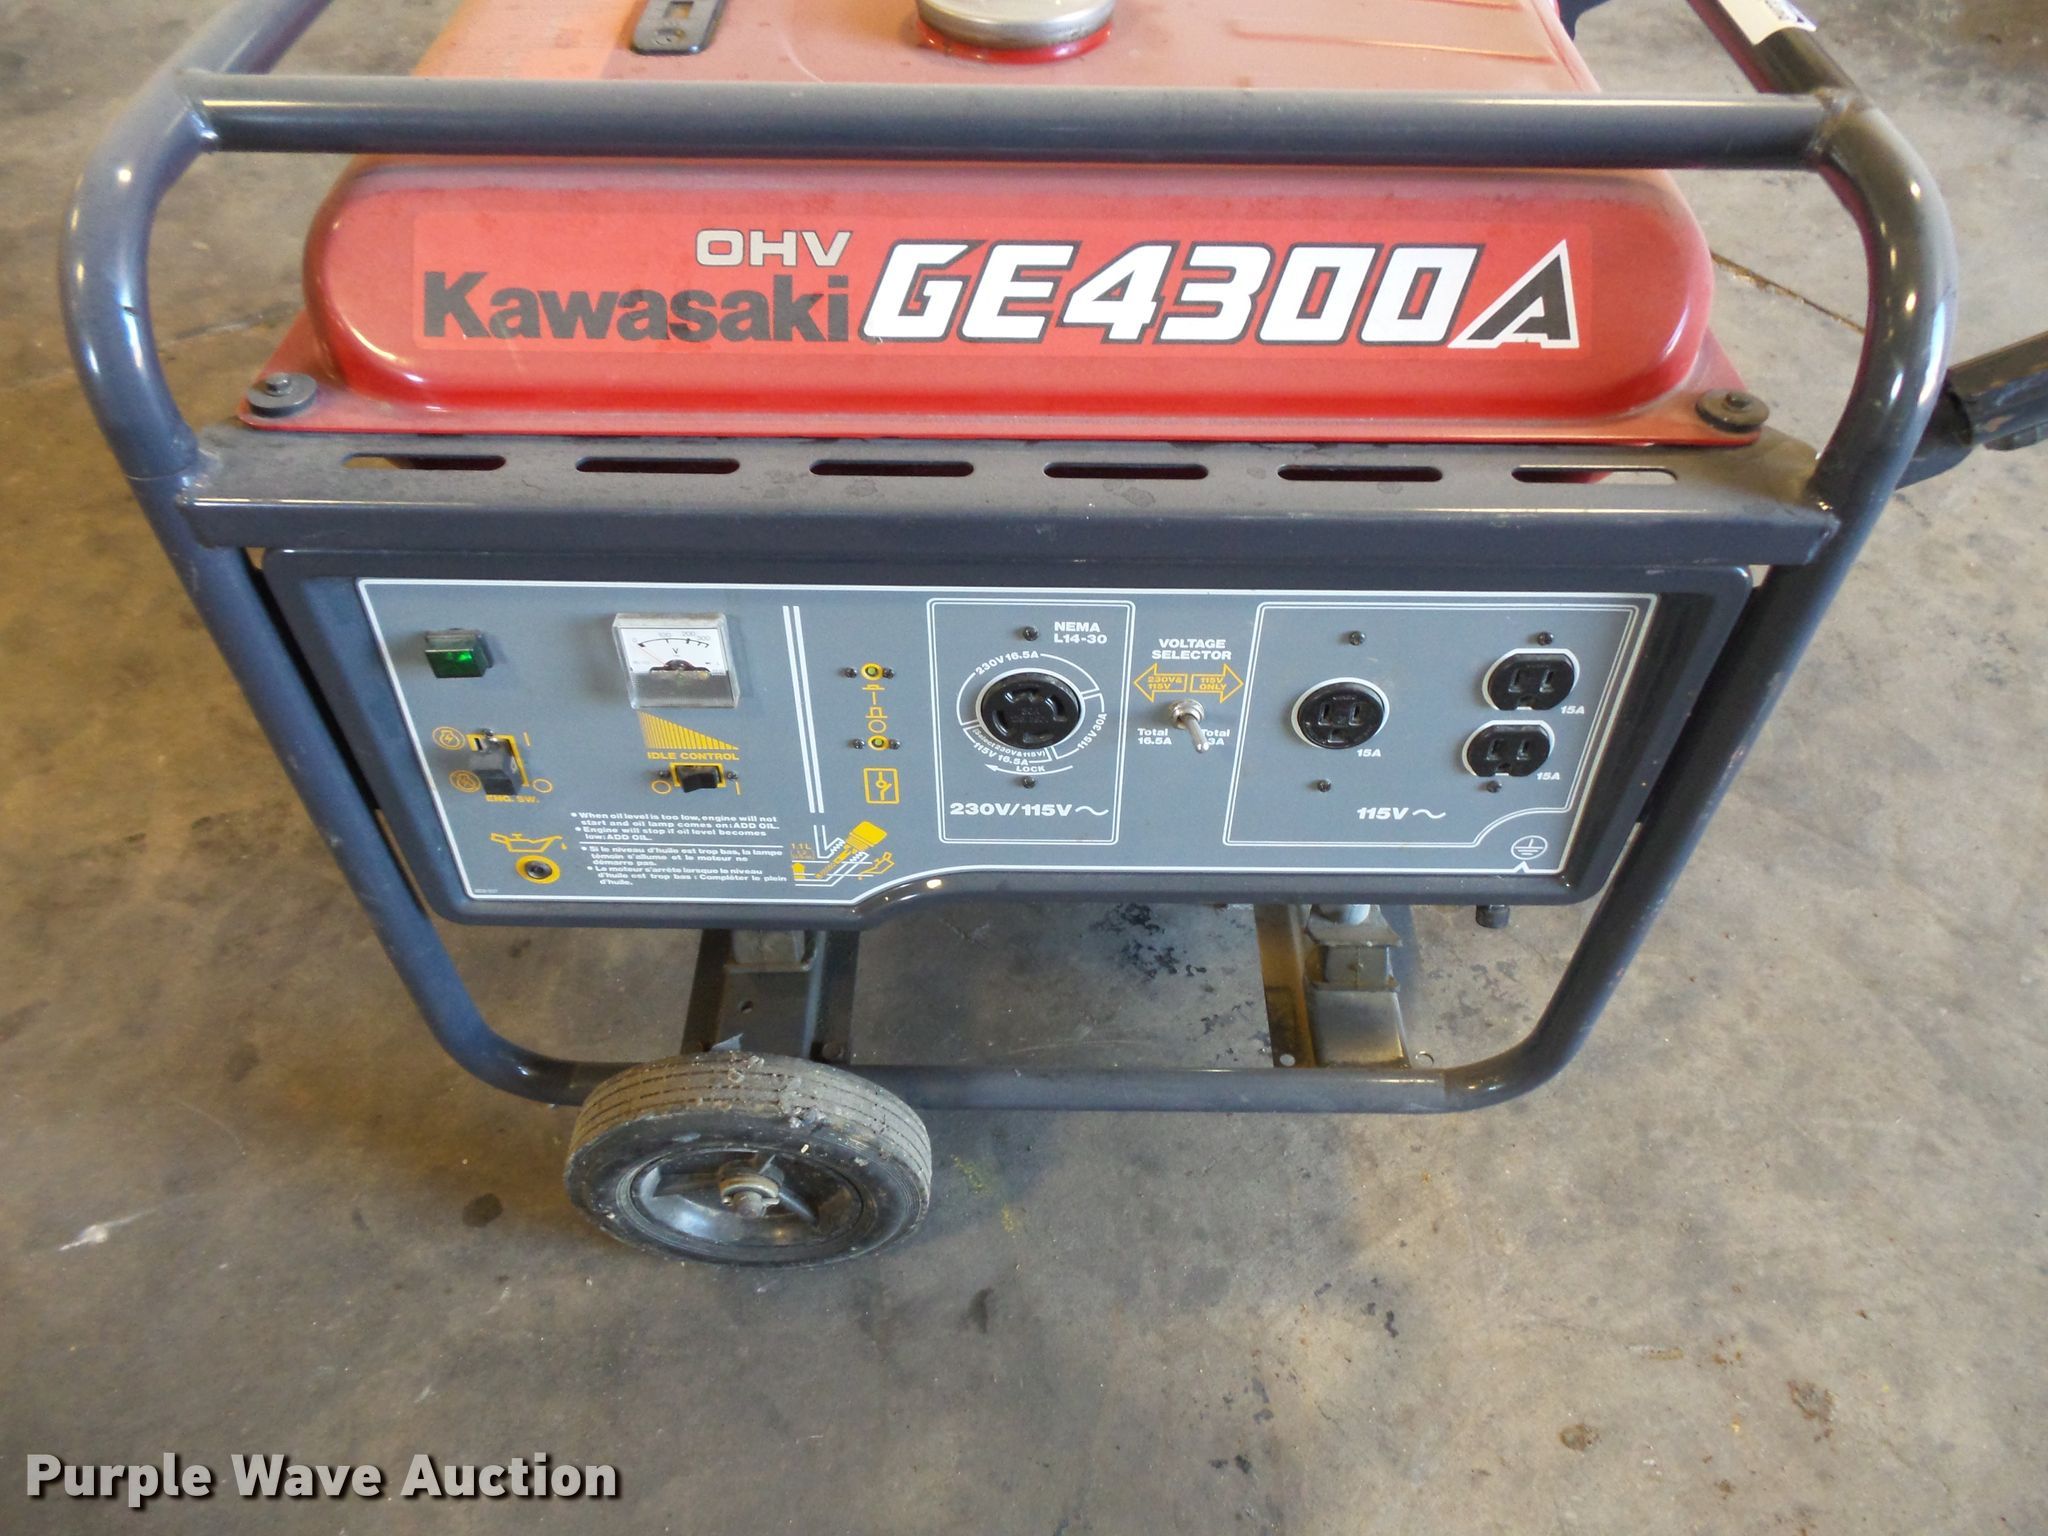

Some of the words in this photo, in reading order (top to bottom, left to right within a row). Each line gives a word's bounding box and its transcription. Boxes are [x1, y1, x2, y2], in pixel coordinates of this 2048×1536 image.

[695, 229, 853, 267] OHV
[423, 271, 850, 343] Kawasaki
[1054, 621, 1101, 633] NEMA
[1054, 633, 1108, 644] L14-30
[1158, 638, 1227, 649] VOLTAGE
[1151, 650, 1233, 661] SELECTOR
[1199, 683, 1227, 691] ONLY
[1561, 705, 1585, 714] 15A
[1137, 728, 1169, 736] Total
[1202, 729, 1231, 737] Total
[1137, 737, 1172, 745] 16.5A
[647, 752, 677, 760] IDLE
[680, 752, 740, 761] CONTROL
[973, 742, 996, 759] 115V
[998, 755, 1029, 767] 16.5A
[1357, 748, 1382, 757] 15A
[1016, 765, 1046, 773] LOCK
[1536, 772, 1560, 780] 15A
[949, 803, 1073, 817] 230V/115V
[1357, 807, 1409, 821] 115V
[648, 820, 675, 828] lamp
[583, 826, 619, 834] Engine
[691, 828, 717, 836] level
[719, 828, 767, 837] becomes
[698, 848, 719, 856] trop
[753, 849, 784, 857] lampe
